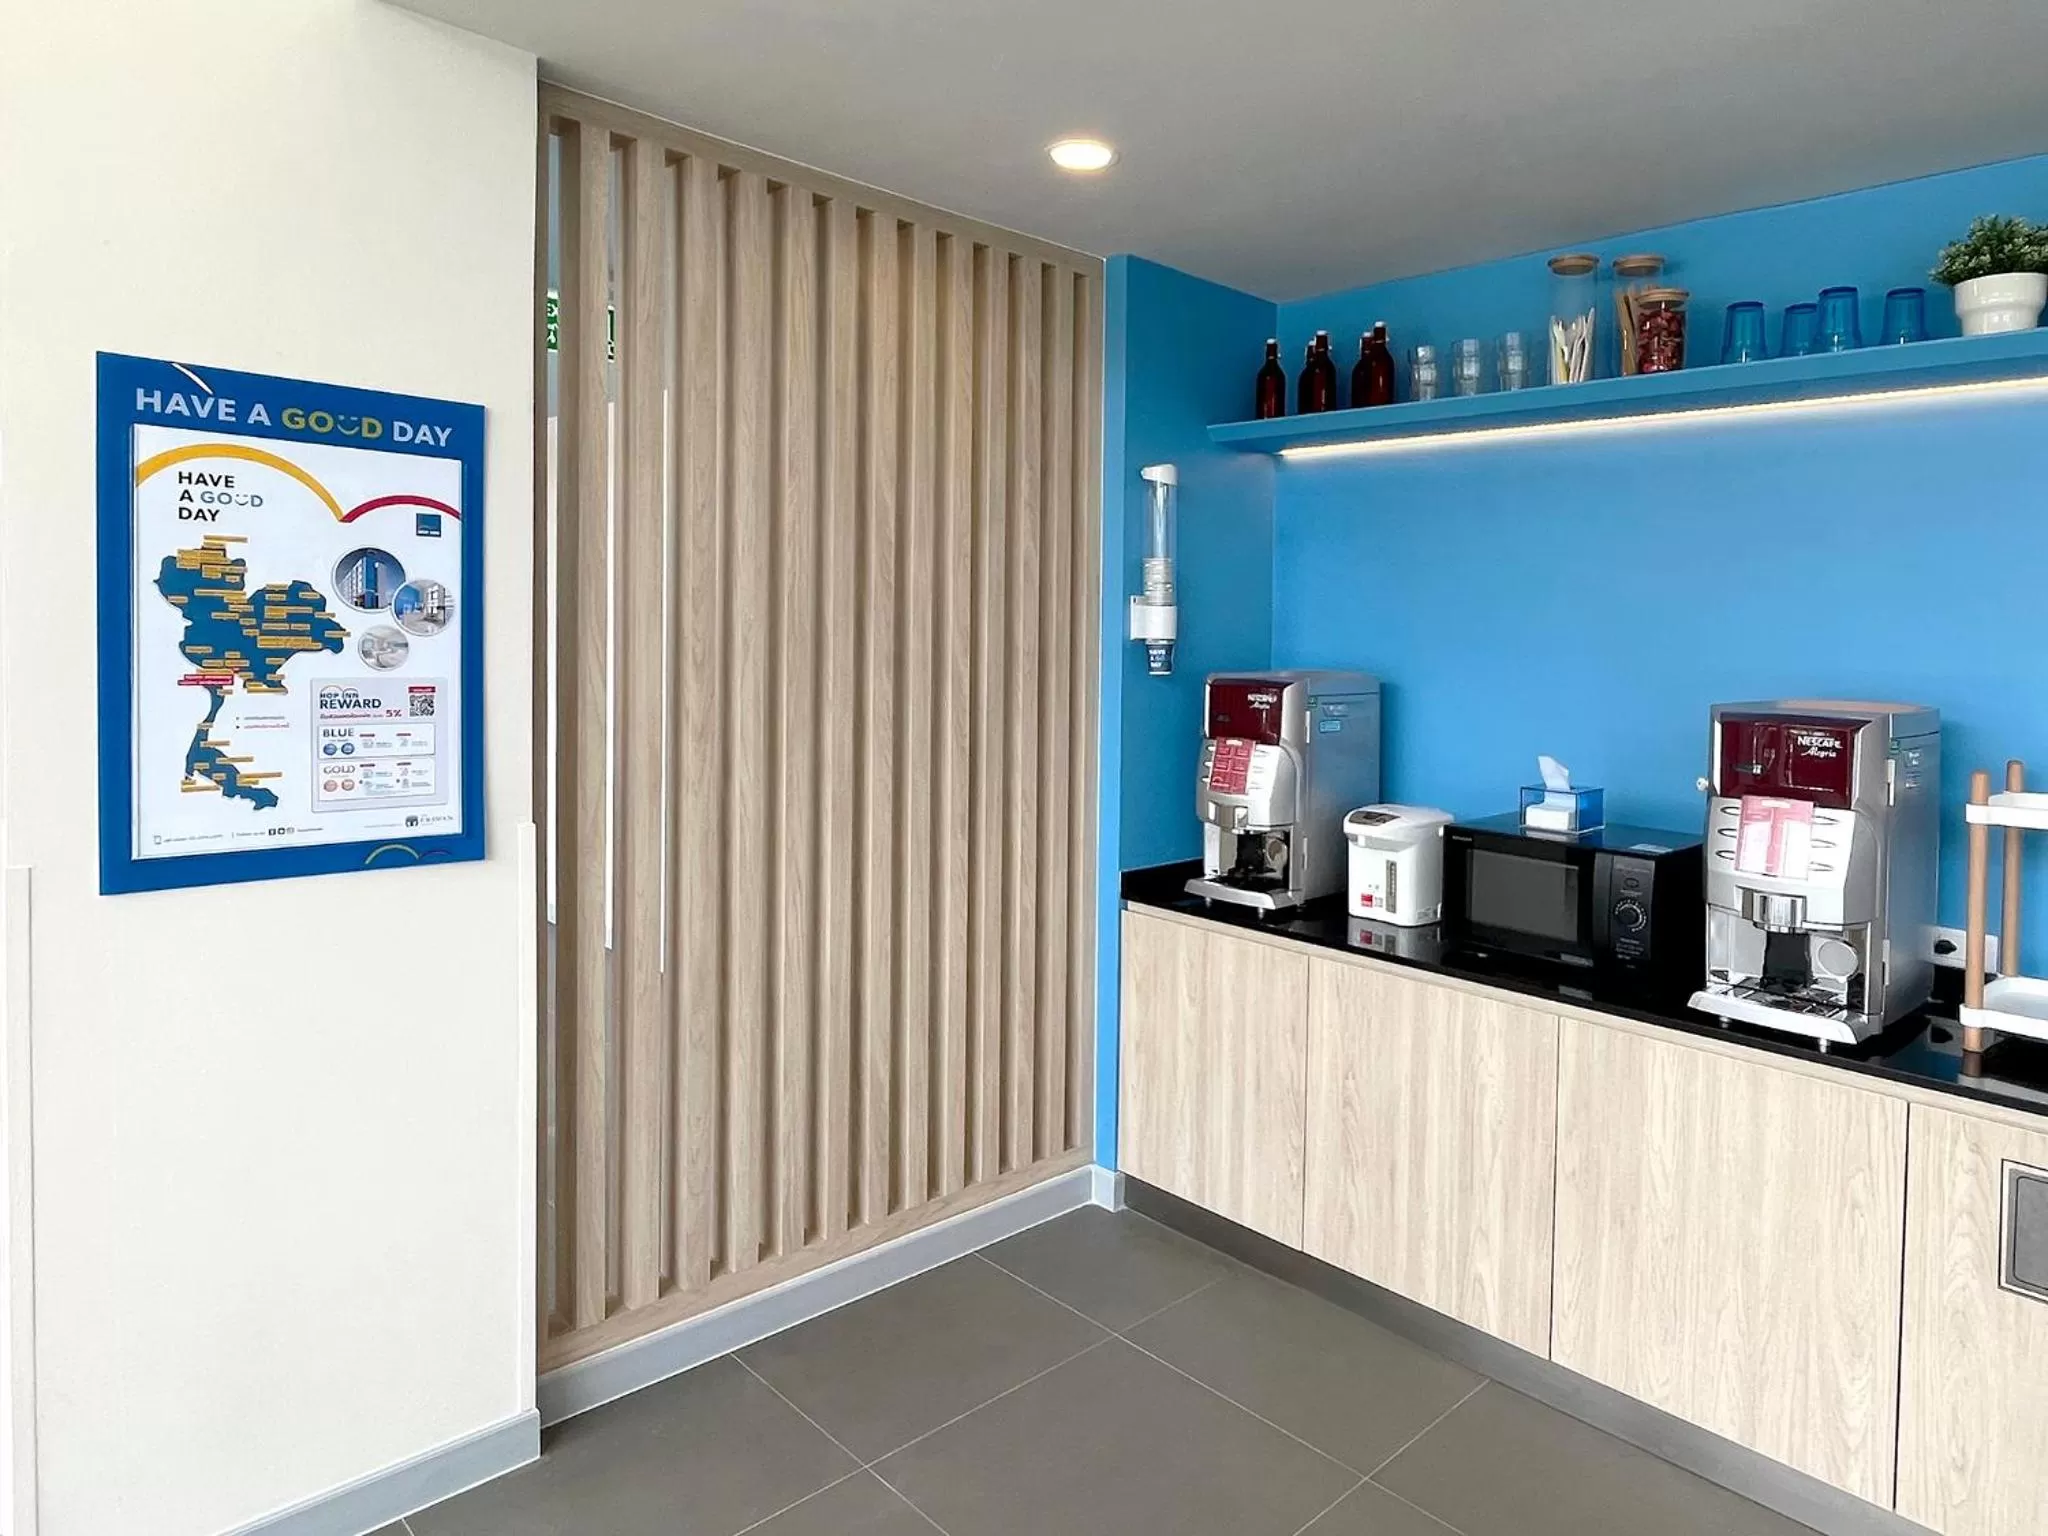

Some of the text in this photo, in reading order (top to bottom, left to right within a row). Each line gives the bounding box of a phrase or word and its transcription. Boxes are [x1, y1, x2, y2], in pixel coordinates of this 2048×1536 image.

[136, 388, 236, 422] HAVE
[247, 403, 272, 426] A
[393, 421, 452, 447] DAY
[178, 471, 235, 488] HAVE
[179, 489, 194, 503] A
[178, 507, 220, 522] DAY
[320, 699, 382, 709] REWARD
[385, 709, 402, 718] 5%
[323, 728, 355, 738] BLUE
[323, 765, 355, 775] GOLD
